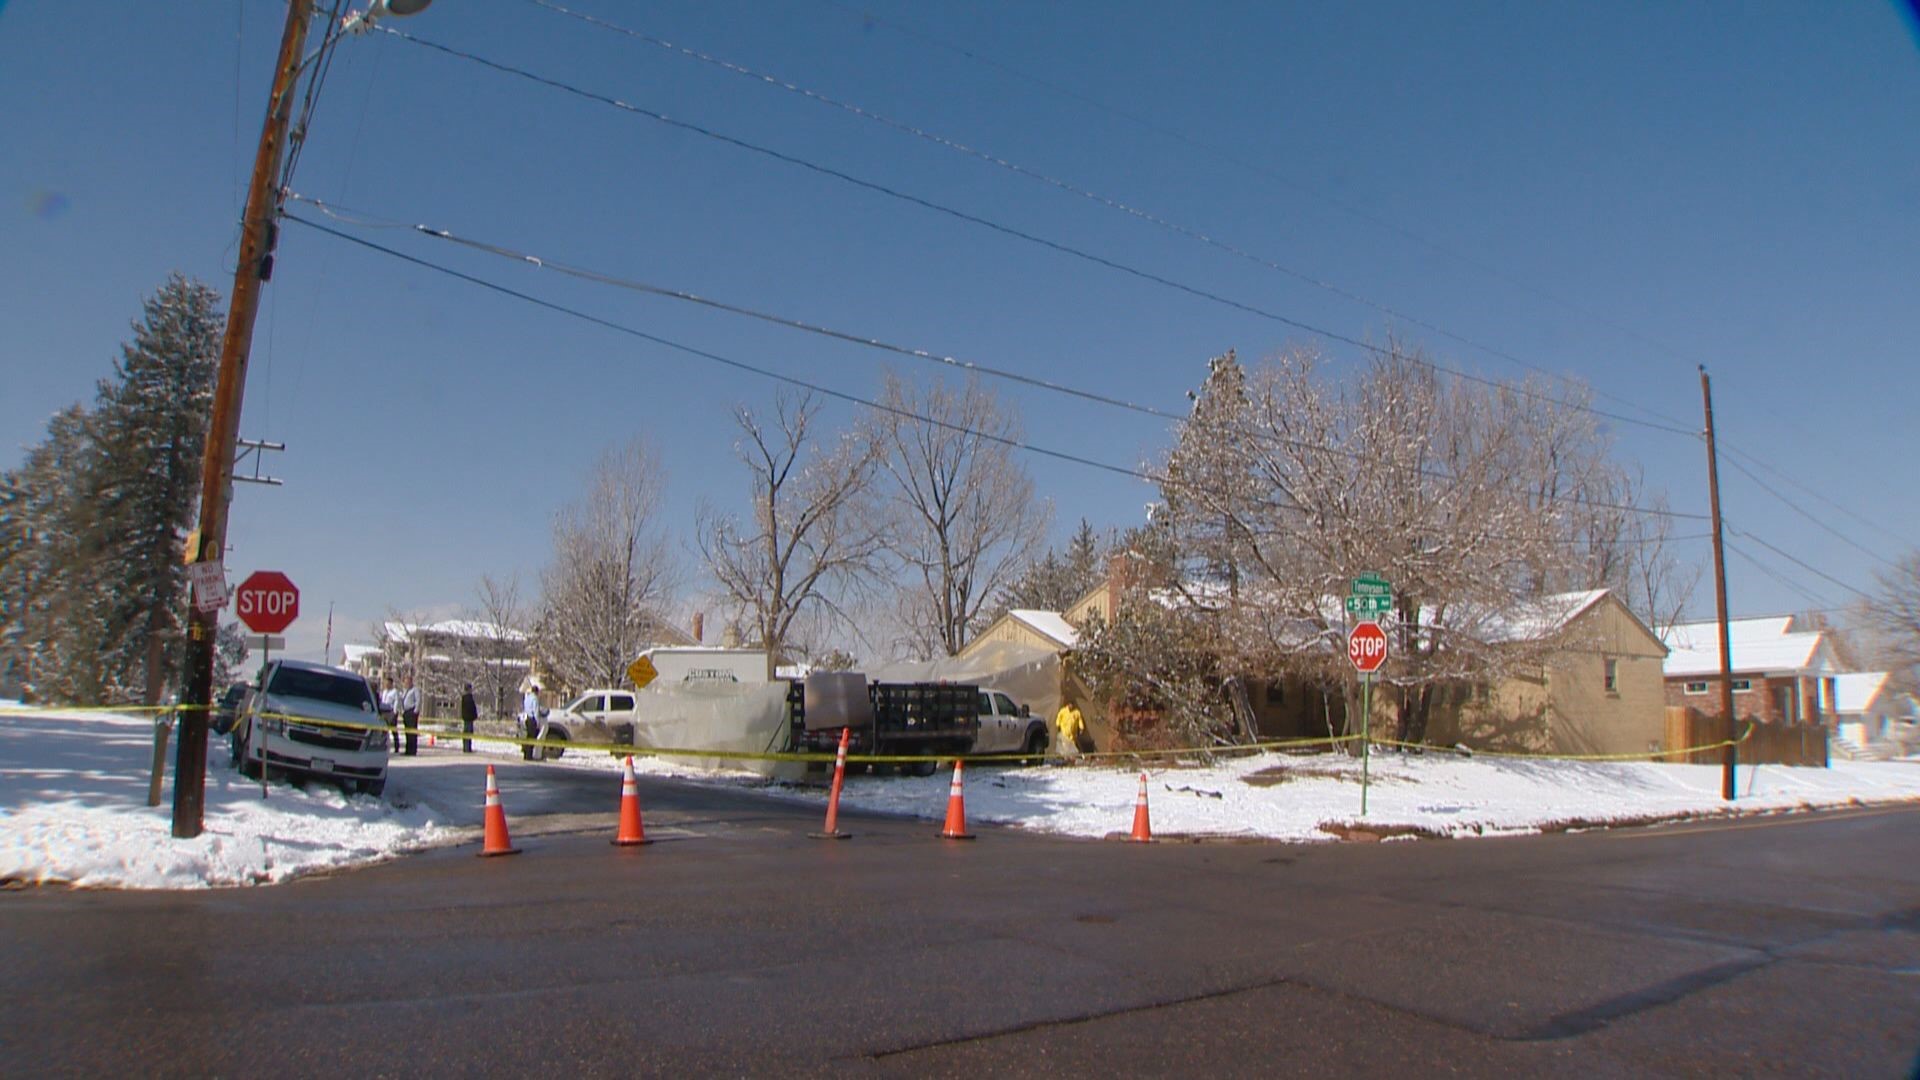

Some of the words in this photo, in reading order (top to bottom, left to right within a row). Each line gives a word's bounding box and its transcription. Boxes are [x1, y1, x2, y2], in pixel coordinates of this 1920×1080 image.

[1354, 580, 1384, 595] Tennyson
[240, 590, 296, 615] STOP
[1354, 598, 1377, 610] 50th
[1350, 637, 1384, 656] STOP
